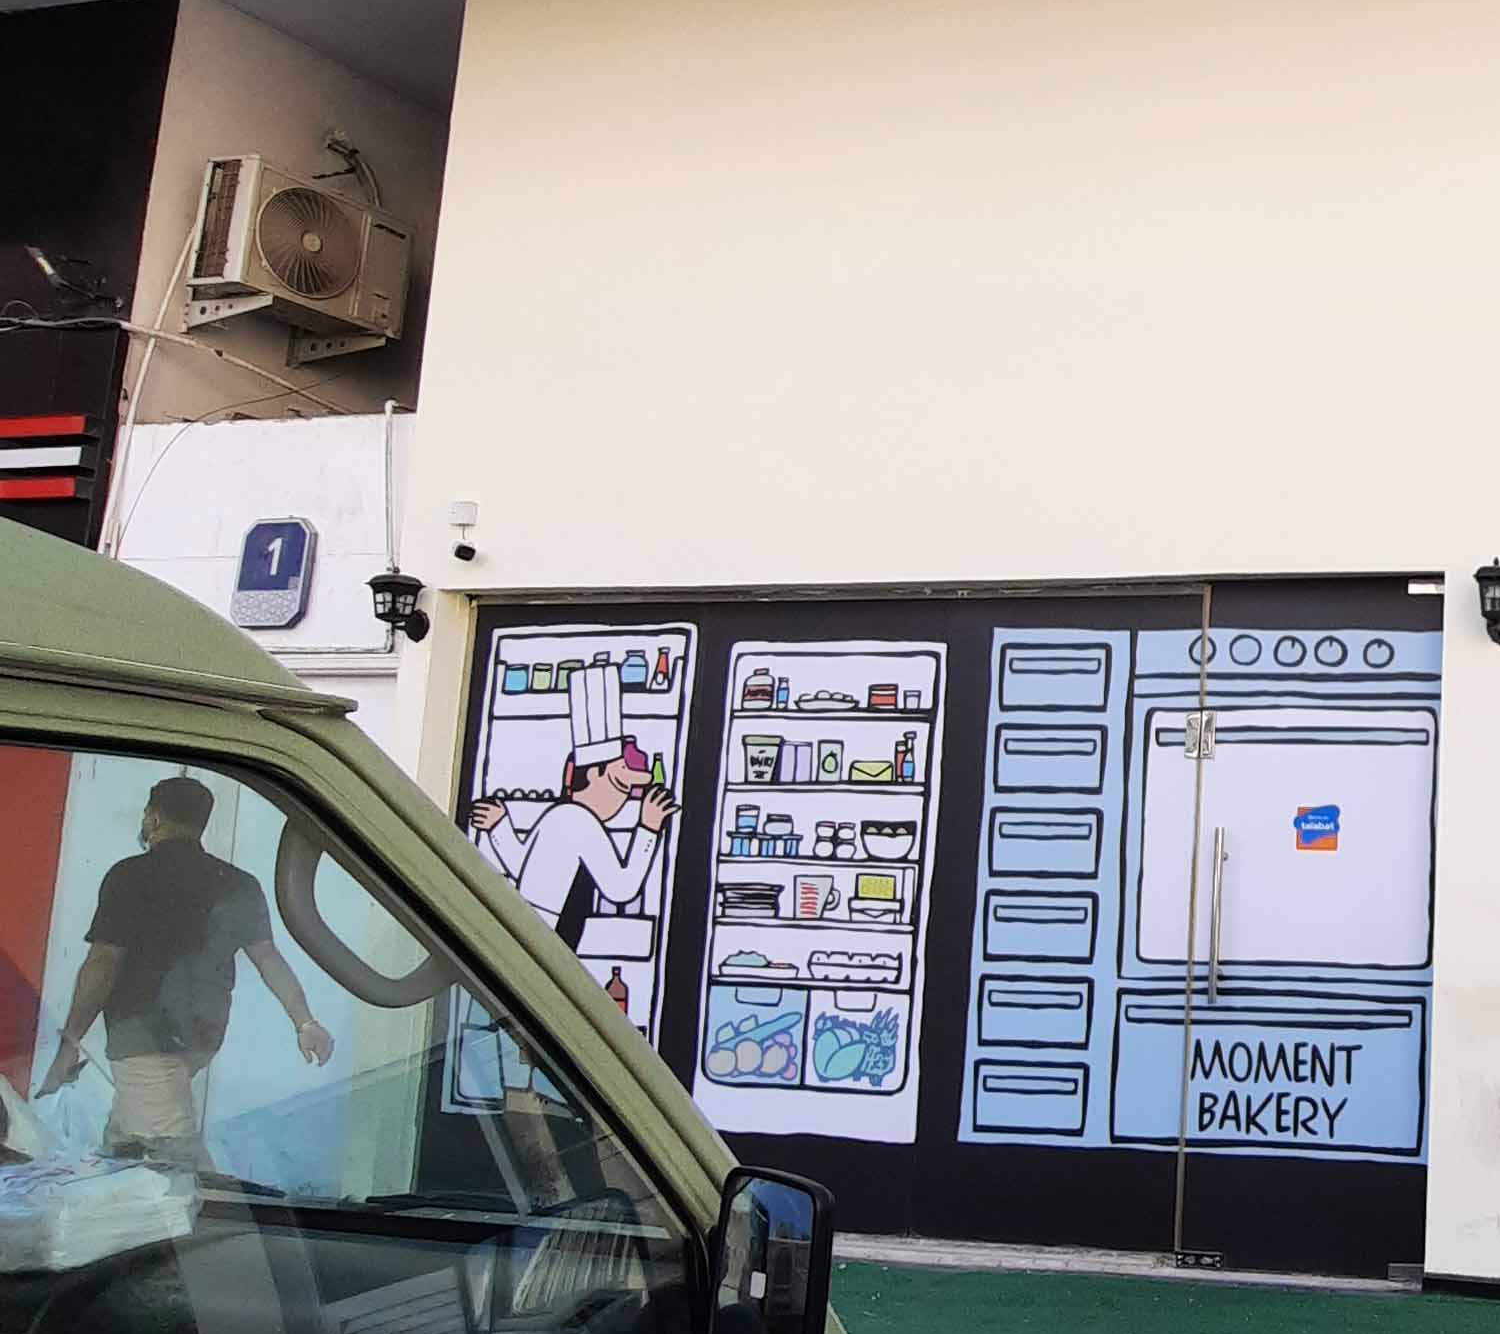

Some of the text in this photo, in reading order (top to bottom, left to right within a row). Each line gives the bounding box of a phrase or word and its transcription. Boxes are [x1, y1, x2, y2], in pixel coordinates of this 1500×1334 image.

[267, 536, 283, 576] 1
[1190, 1038, 1363, 1087] MOMENT
[1199, 1090, 1348, 1139] BAKERY
